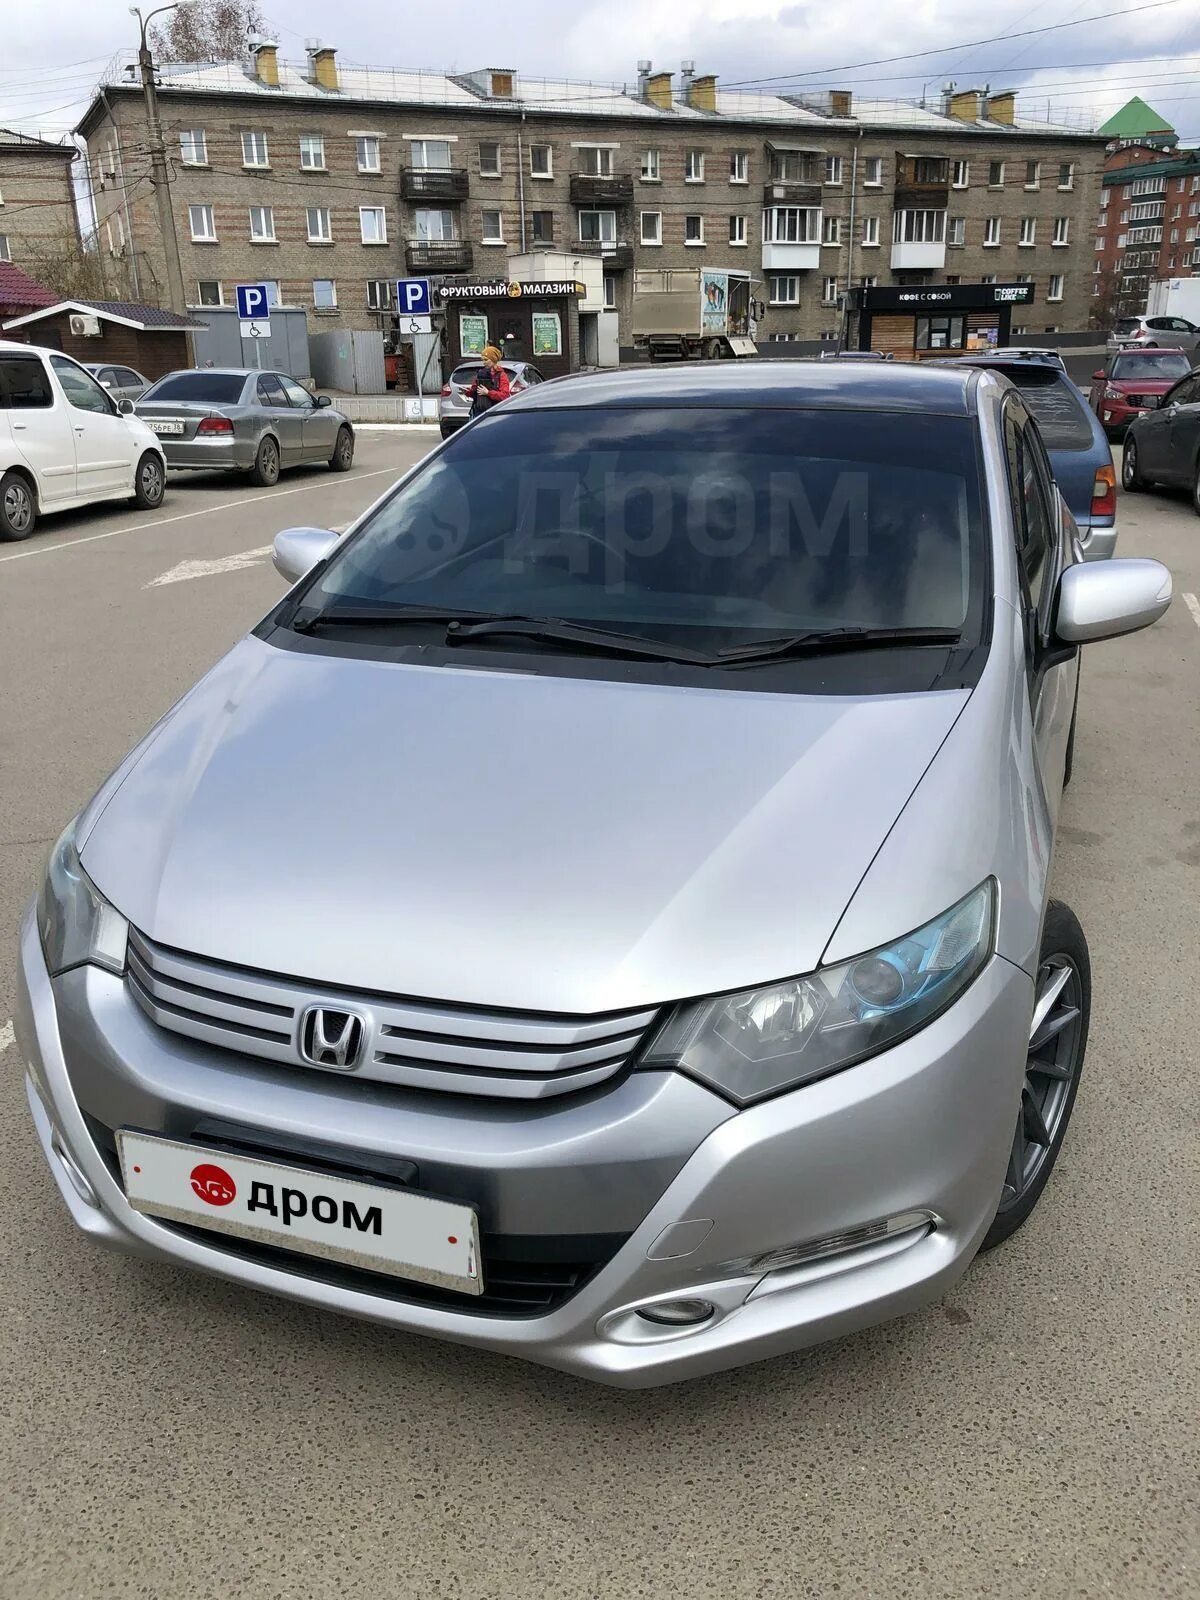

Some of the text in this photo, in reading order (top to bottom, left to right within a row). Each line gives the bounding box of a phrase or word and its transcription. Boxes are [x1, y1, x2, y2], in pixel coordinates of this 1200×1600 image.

[406, 283, 423, 310] P
[440, 283, 575, 297] ФРУКТОВЫЙ МАГАЗИН
[926, 292, 952, 300] СОБОЙ
[245, 288, 262, 315] P
